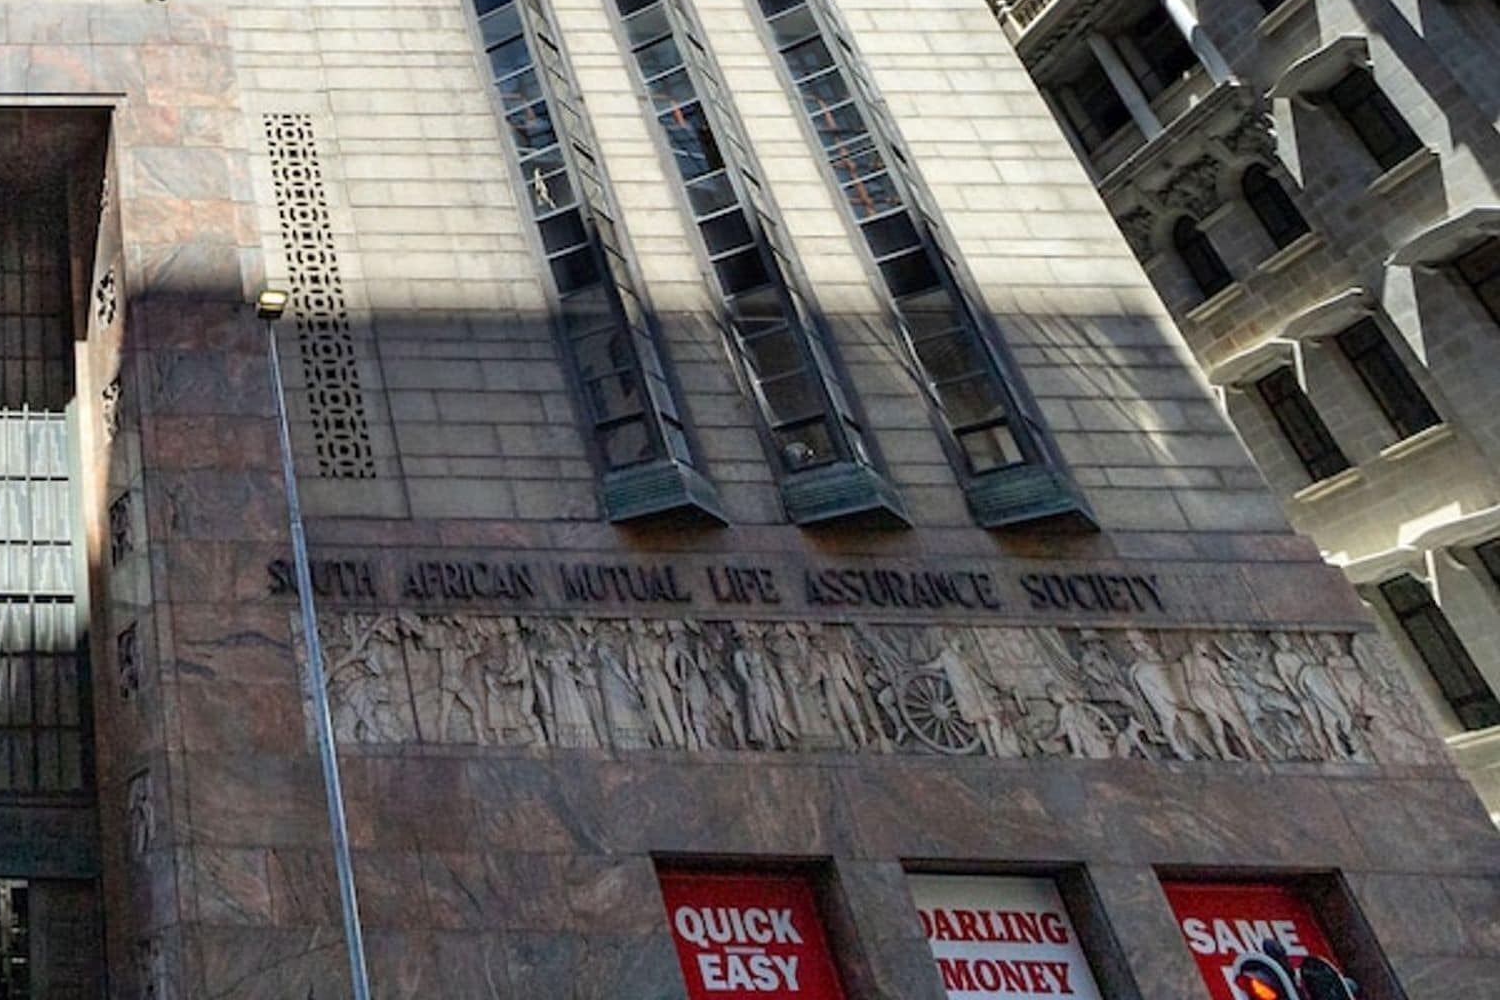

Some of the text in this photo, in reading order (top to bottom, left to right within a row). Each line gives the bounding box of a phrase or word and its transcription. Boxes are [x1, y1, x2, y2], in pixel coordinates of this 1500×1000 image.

[402, 560, 536, 599] AFRICAN
[558, 562, 693, 603] MUTUAL
[704, 565, 781, 604] LIFE
[802, 566, 1000, 610] ASSURANCE
[1019, 571, 1168, 614] SOCIETY
[674, 905, 804, 948] QUICK
[1182, 917, 1310, 957] SAME
[697, 952, 800, 992] EASY
[935, 957, 1074, 994] MONEY
